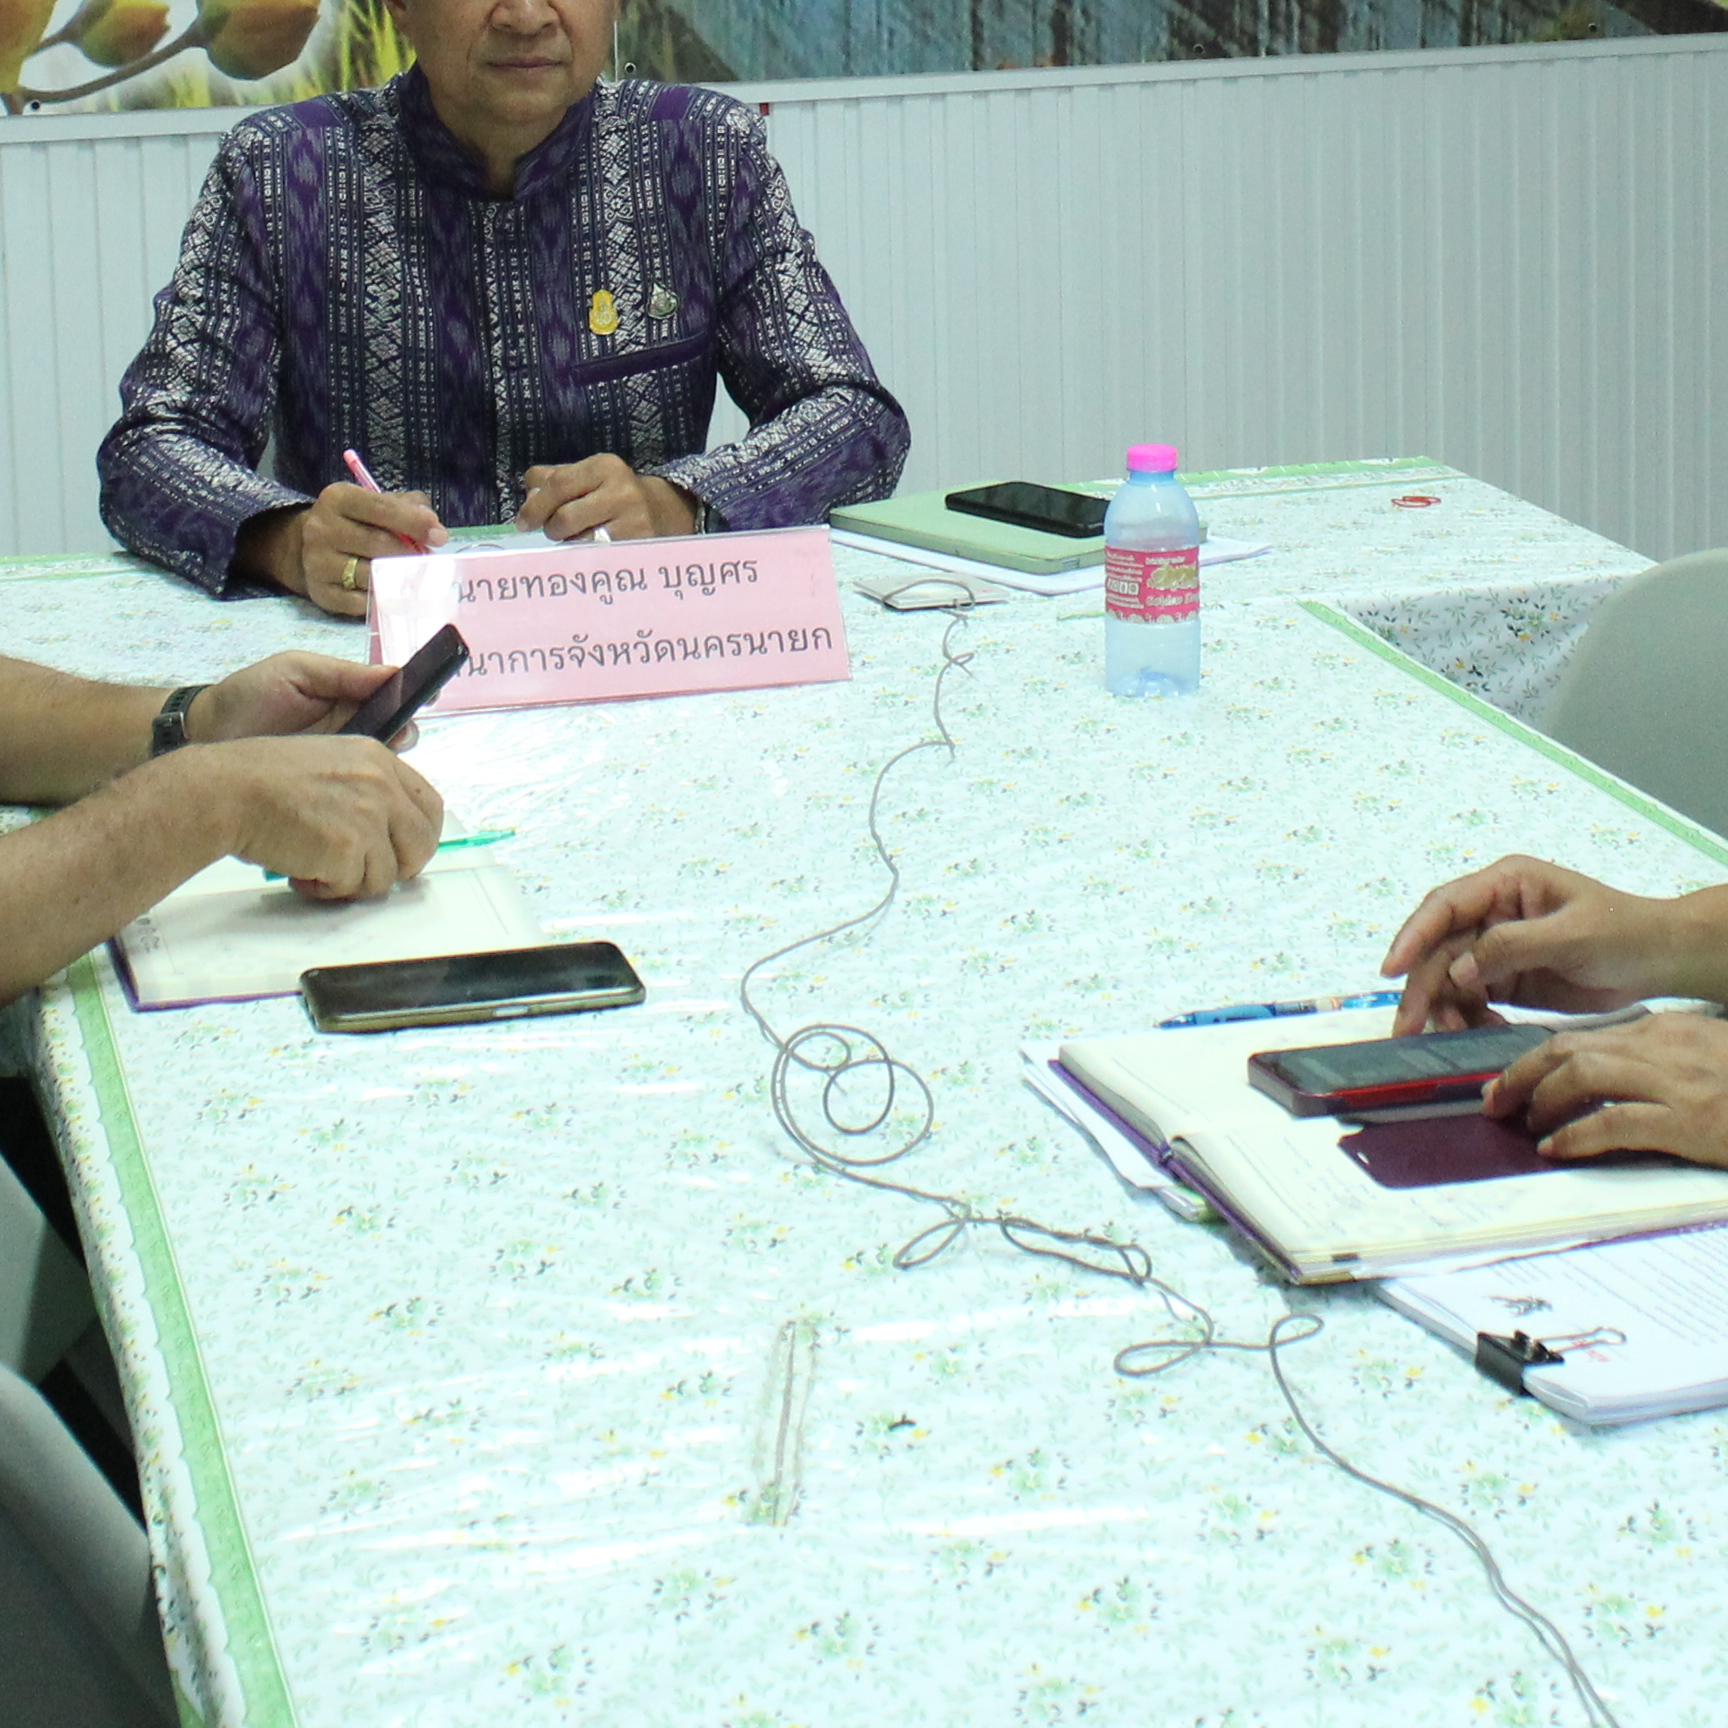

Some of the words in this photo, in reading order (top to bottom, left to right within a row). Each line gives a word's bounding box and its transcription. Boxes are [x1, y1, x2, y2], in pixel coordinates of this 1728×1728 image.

[452, 564, 648, 607] นายทองคูณ
[658, 554, 760, 600] บุญศร
[457, 623, 833, 678] นาการจังหวัดนครนายก
